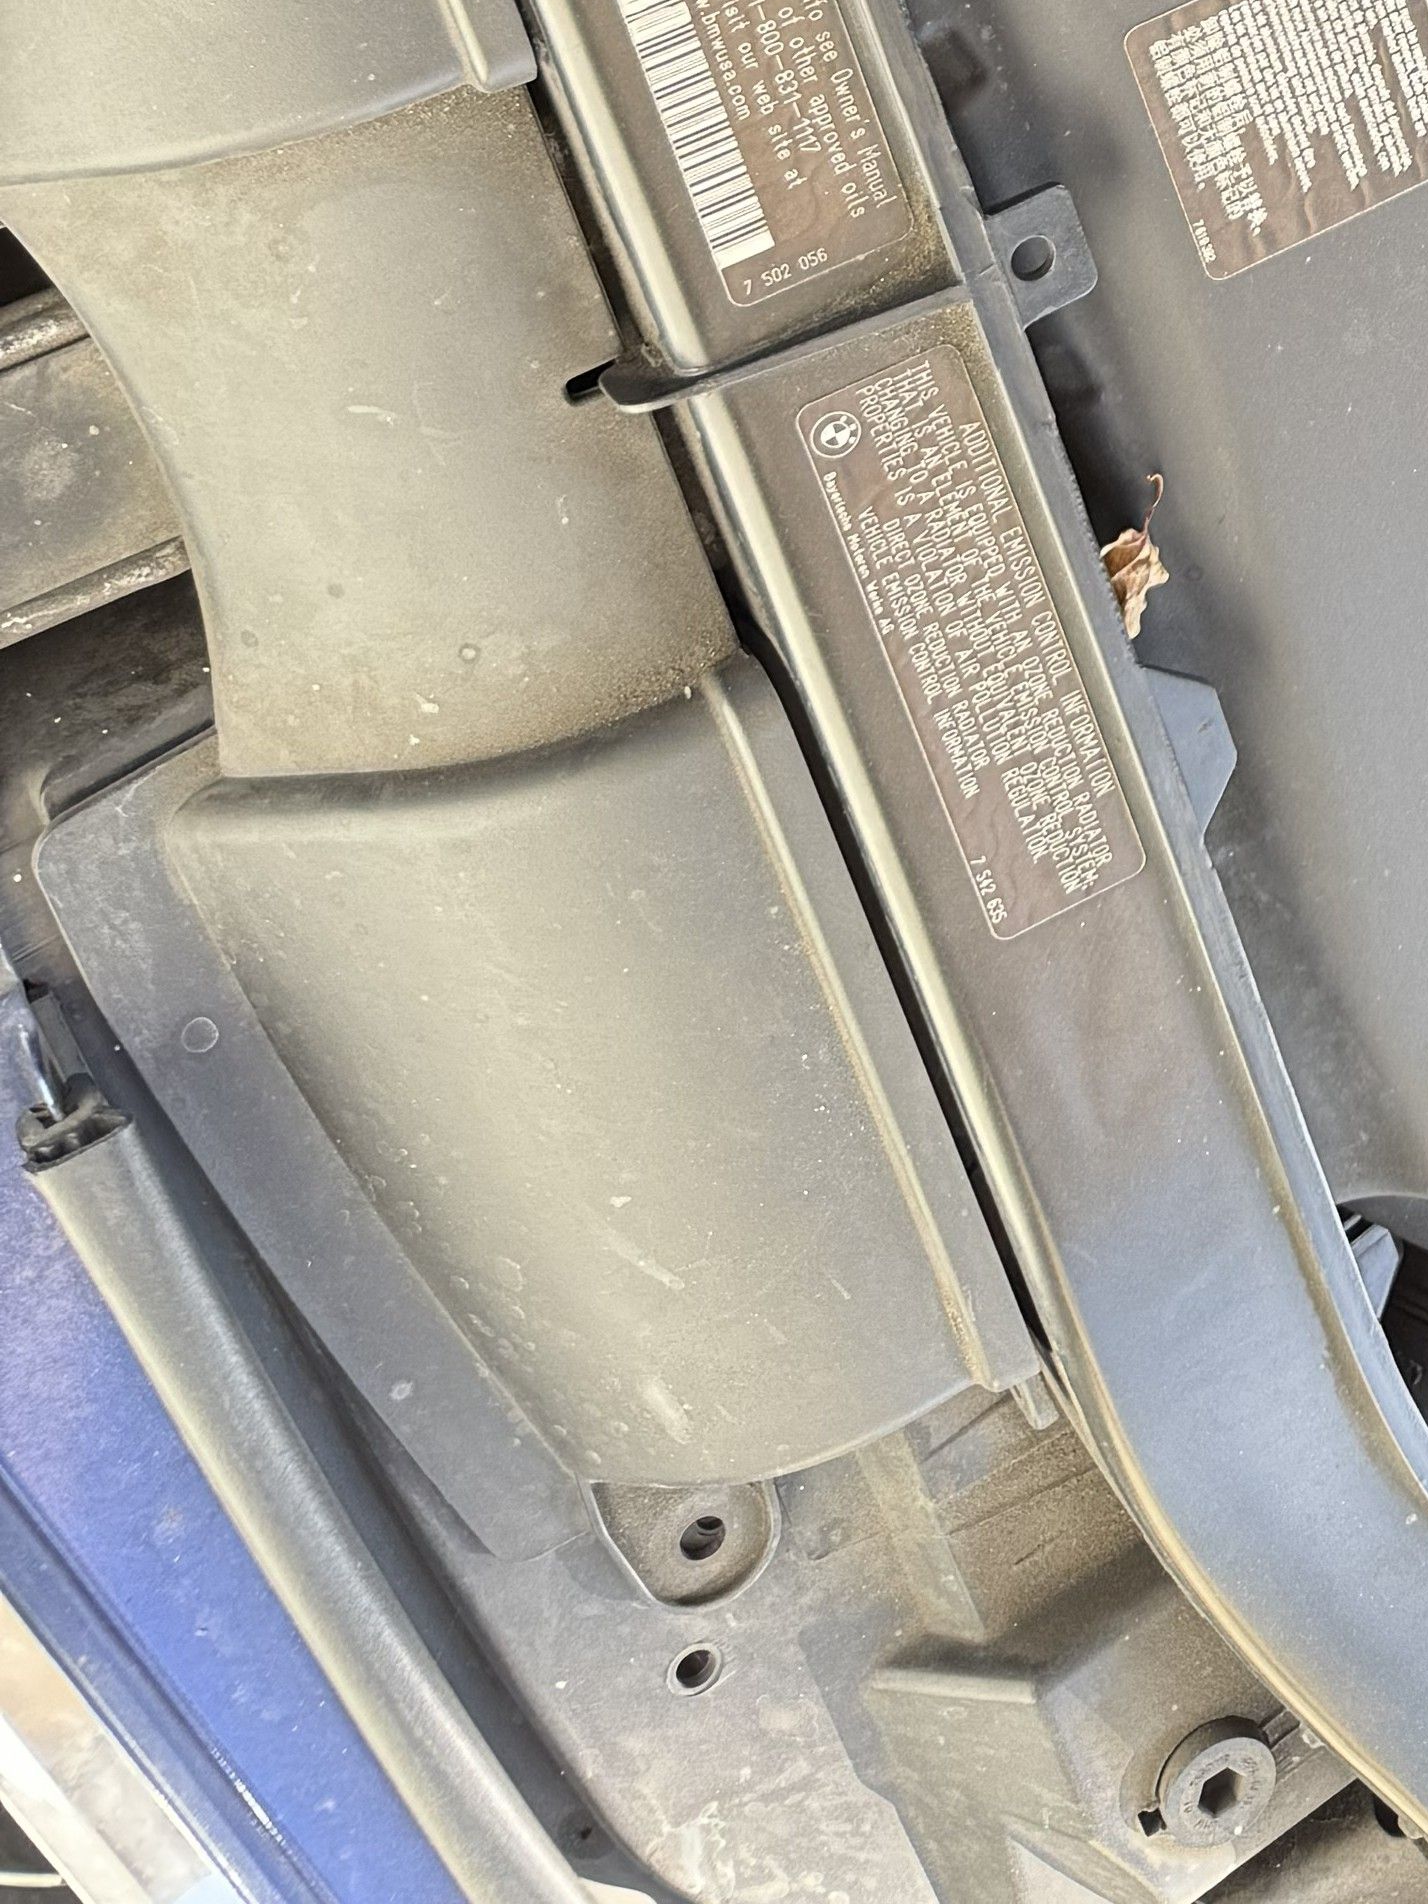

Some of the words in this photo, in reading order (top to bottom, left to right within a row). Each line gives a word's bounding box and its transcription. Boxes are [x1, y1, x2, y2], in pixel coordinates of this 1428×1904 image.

[777, 6, 805, 27] of
[788, 36, 818, 83] other
[736, 41, 759, 69] our
[751, 79, 779, 115] web
[767, 123, 793, 160] site
[783, 168, 806, 189] at
[808, 93, 855, 175] approved
[814, 30, 838, 62] see
[830, 67, 869, 139] Owner's
[856, 143, 897, 208] Manual
[840, 181, 868, 218] oils
[742, 278, 752, 295] 7
[760, 262, 792, 287] 502
[797, 246, 828, 270] 056
[891, 368, 923, 413] THAT
[909, 359, 939, 402] THIS
[855, 384, 906, 481] PROPERTIES
[873, 376, 918, 457] CHANGING
[910, 417, 933, 439] IS
[927, 403, 968, 476] VEHICLE
[904, 459, 929, 484] TO
[919, 445, 944, 469] AN
[954, 479, 977, 500] IS
[893, 485, 915, 506] IS
[902, 512, 922, 528] A
[915, 490, 935, 505] A
[930, 471, 972, 542] ELEMENT
[912, 529, 957, 616] VIOLATION
[924, 507, 967, 588] RADIATOR
[957, 547, 983, 568] OF
[962, 502, 1005, 579] EQUIPPED
[956, 590, 994, 658] WITHOUT
[958, 421, 1012, 523] ADDITIONAL
[998, 526, 1045, 608] EMISSION
[1030, 610, 1072, 686] CONTROL
[1059, 689, 1114, 797] INFORMATION
[970, 575, 996, 607] THE
[992, 580, 1022, 626] WITH
[857, 505, 893, 570] VEHICLE
[881, 571, 919, 640] EMISSION
[907, 642, 942, 705] CONTROL
[933, 708, 979, 798] INFORMATION
[877, 617, 894, 635] AG
[881, 517, 915, 569] DIRECT
[903, 573, 934, 619] OZONE
[922, 621, 962, 698] REDUCTION
[951, 699, 990, 770] RADIATOR
[944, 619, 968, 639] OF
[984, 610, 1022, 677] VEHICLE
[1008, 629, 1033, 653] AN
[953, 648, 980, 679] AIR
[1020, 655, 1053, 705] OZONE
[968, 680, 1013, 765] POLLUTION
[981, 662, 1031, 757] EQUIVALENT
[1009, 680, 1050, 754] EMISSION
[1040, 707, 1084, 790] REDUCTION
[1001, 767, 1048, 864] REGULATION.
[1016, 761, 1051, 811] OZONE
[1037, 756, 1074, 826] CONTROL
[1037, 811, 1084, 894] REDUCTION
[1071, 791, 1112, 867] RADIATOR
[969, 854, 987, 865] 7
[985, 897, 1008, 924] 635
